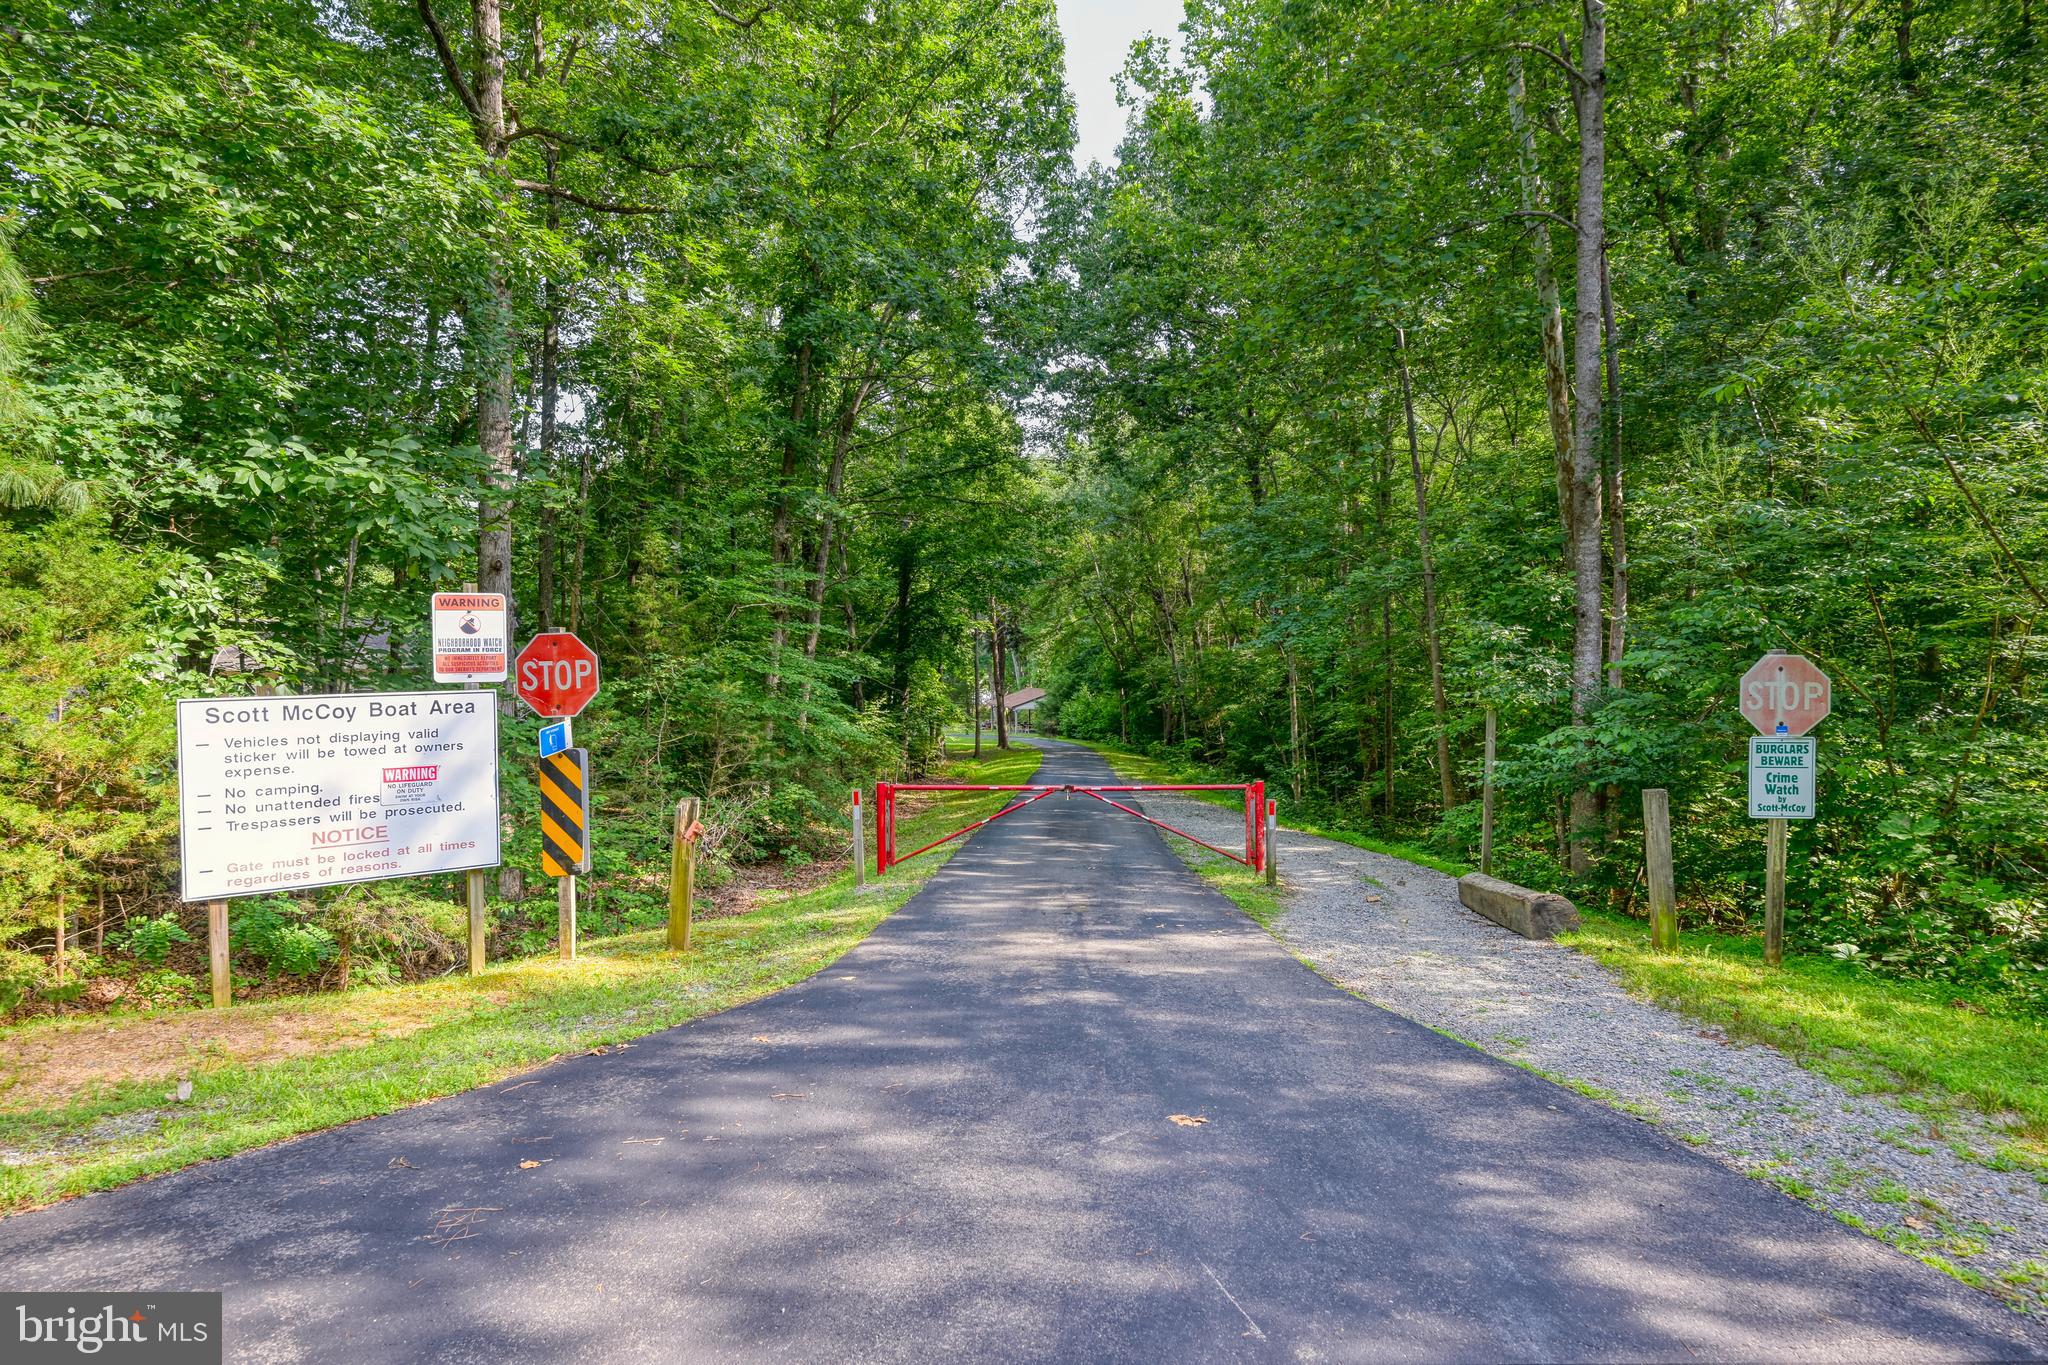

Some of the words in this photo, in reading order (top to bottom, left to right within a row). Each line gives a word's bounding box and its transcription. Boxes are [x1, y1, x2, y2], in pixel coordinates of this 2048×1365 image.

[439, 599, 499, 607] WARNING
[438, 638, 481, 647] NEIGHBORHOOD
[483, 638, 502, 647] WATCH
[522, 659, 592, 692] STOP
[1746, 681, 1824, 711] STOP
[206, 706, 269, 724] Scott
[282, 704, 357, 723] McCoy
[369, 701, 417, 717] Boat
[430, 700, 476, 715] Area
[224, 735, 288, 748] Vehicles
[297, 734, 321, 745] not
[329, 731, 400, 745] displaying
[408, 728, 439, 739] valid
[224, 751, 276, 764] sticker
[286, 749, 309, 760] will
[317, 747, 335, 758] be
[344, 744, 387, 757] towed
[394, 743, 407, 754] at
[414, 741, 464, 753] owners
[1756, 744, 1809, 754] BURGLARS
[1761, 756, 1803, 765] BEWARE
[224, 764, 295, 779] expense.
[385, 767, 435, 781] WARNING
[1766, 772, 1798, 783] Crime
[225, 787, 246, 799] No
[255, 783, 323, 798] camping.
[1765, 784, 1799, 795] Watch
[225, 804, 246, 815] No
[255, 797, 341, 813] unattended
[349, 792, 380, 805] fires
[1757, 804, 1806, 812] Scott-McCoy
[226, 815, 321, 832] Trespassers
[329, 811, 352, 823] will
[359, 809, 377, 820] be
[385, 801, 466, 820] prosecuted.
[312, 826, 388, 844] NOTICE
[227, 861, 264, 874] Gate
[272, 856, 310, 869] must
[317, 853, 336, 864] be
[343, 847, 390, 862] locked
[397, 845, 411, 856] at
[417, 843, 433, 853] all
[440, 839, 475, 851] times
[226, 871, 310, 887] regardless
[318, 866, 333, 877] of
[340, 861, 402, 875] reasons.
